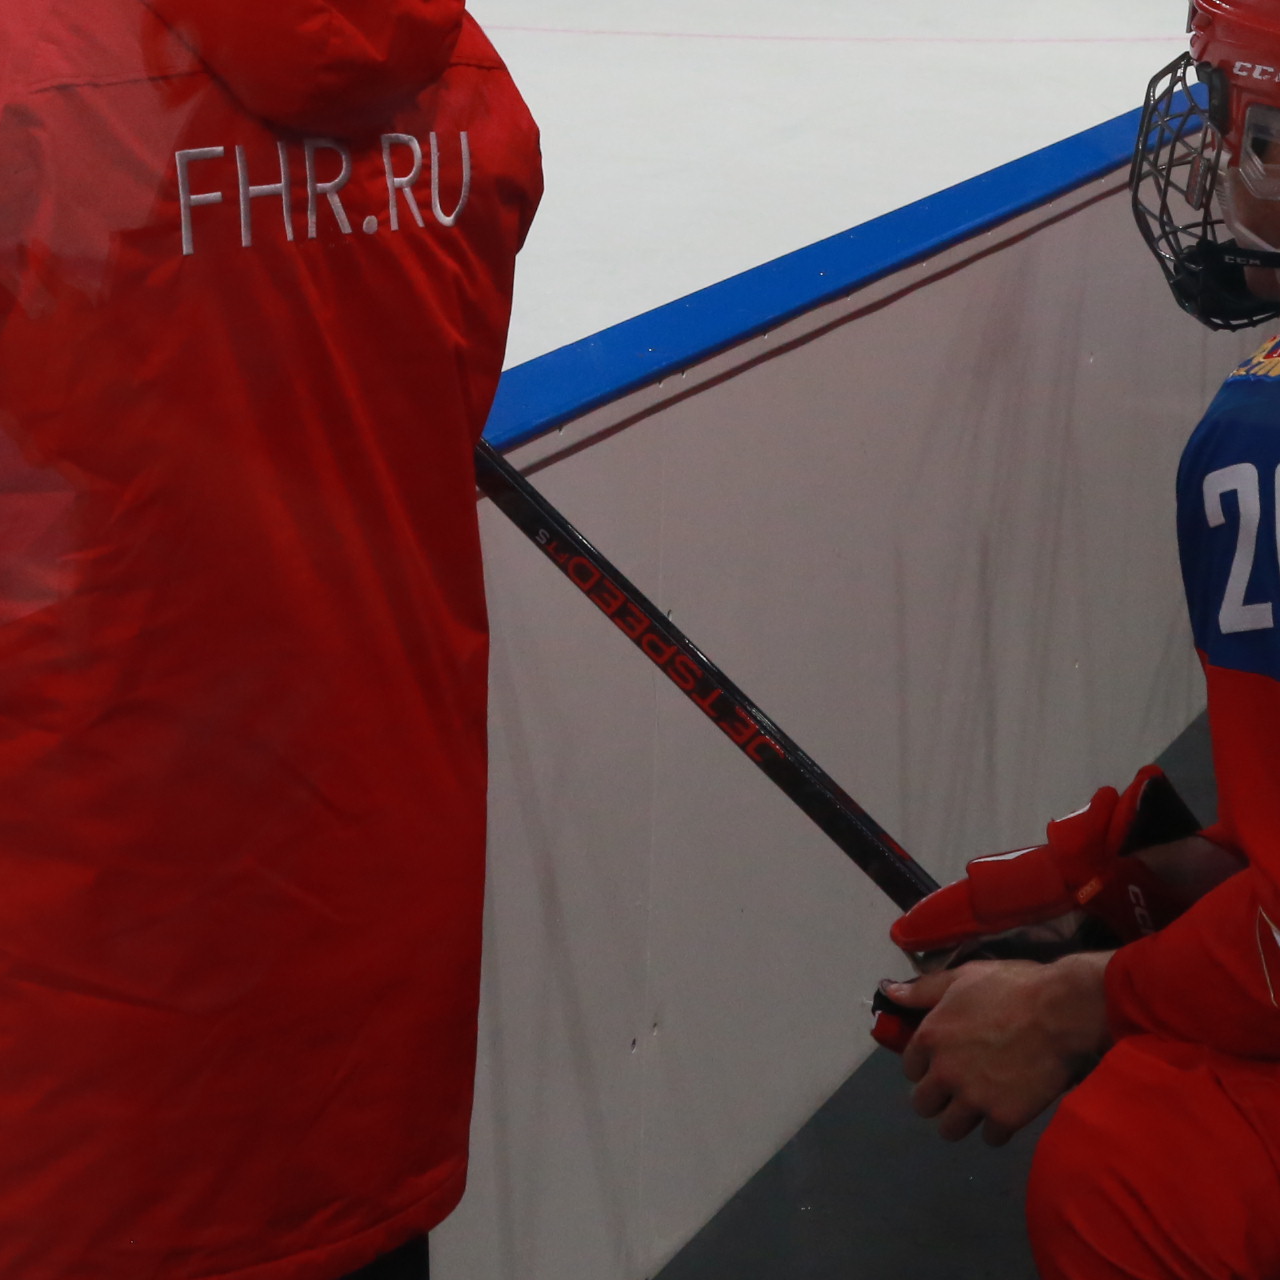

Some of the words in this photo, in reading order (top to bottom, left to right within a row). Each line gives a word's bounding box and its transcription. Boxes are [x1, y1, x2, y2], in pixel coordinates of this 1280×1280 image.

[175, 131, 472, 255] FHR.RU
[1223, 254, 1262, 266] CCM
[565, 556, 785, 763] JETSPEED
[1128, 883, 1155, 936] CC
